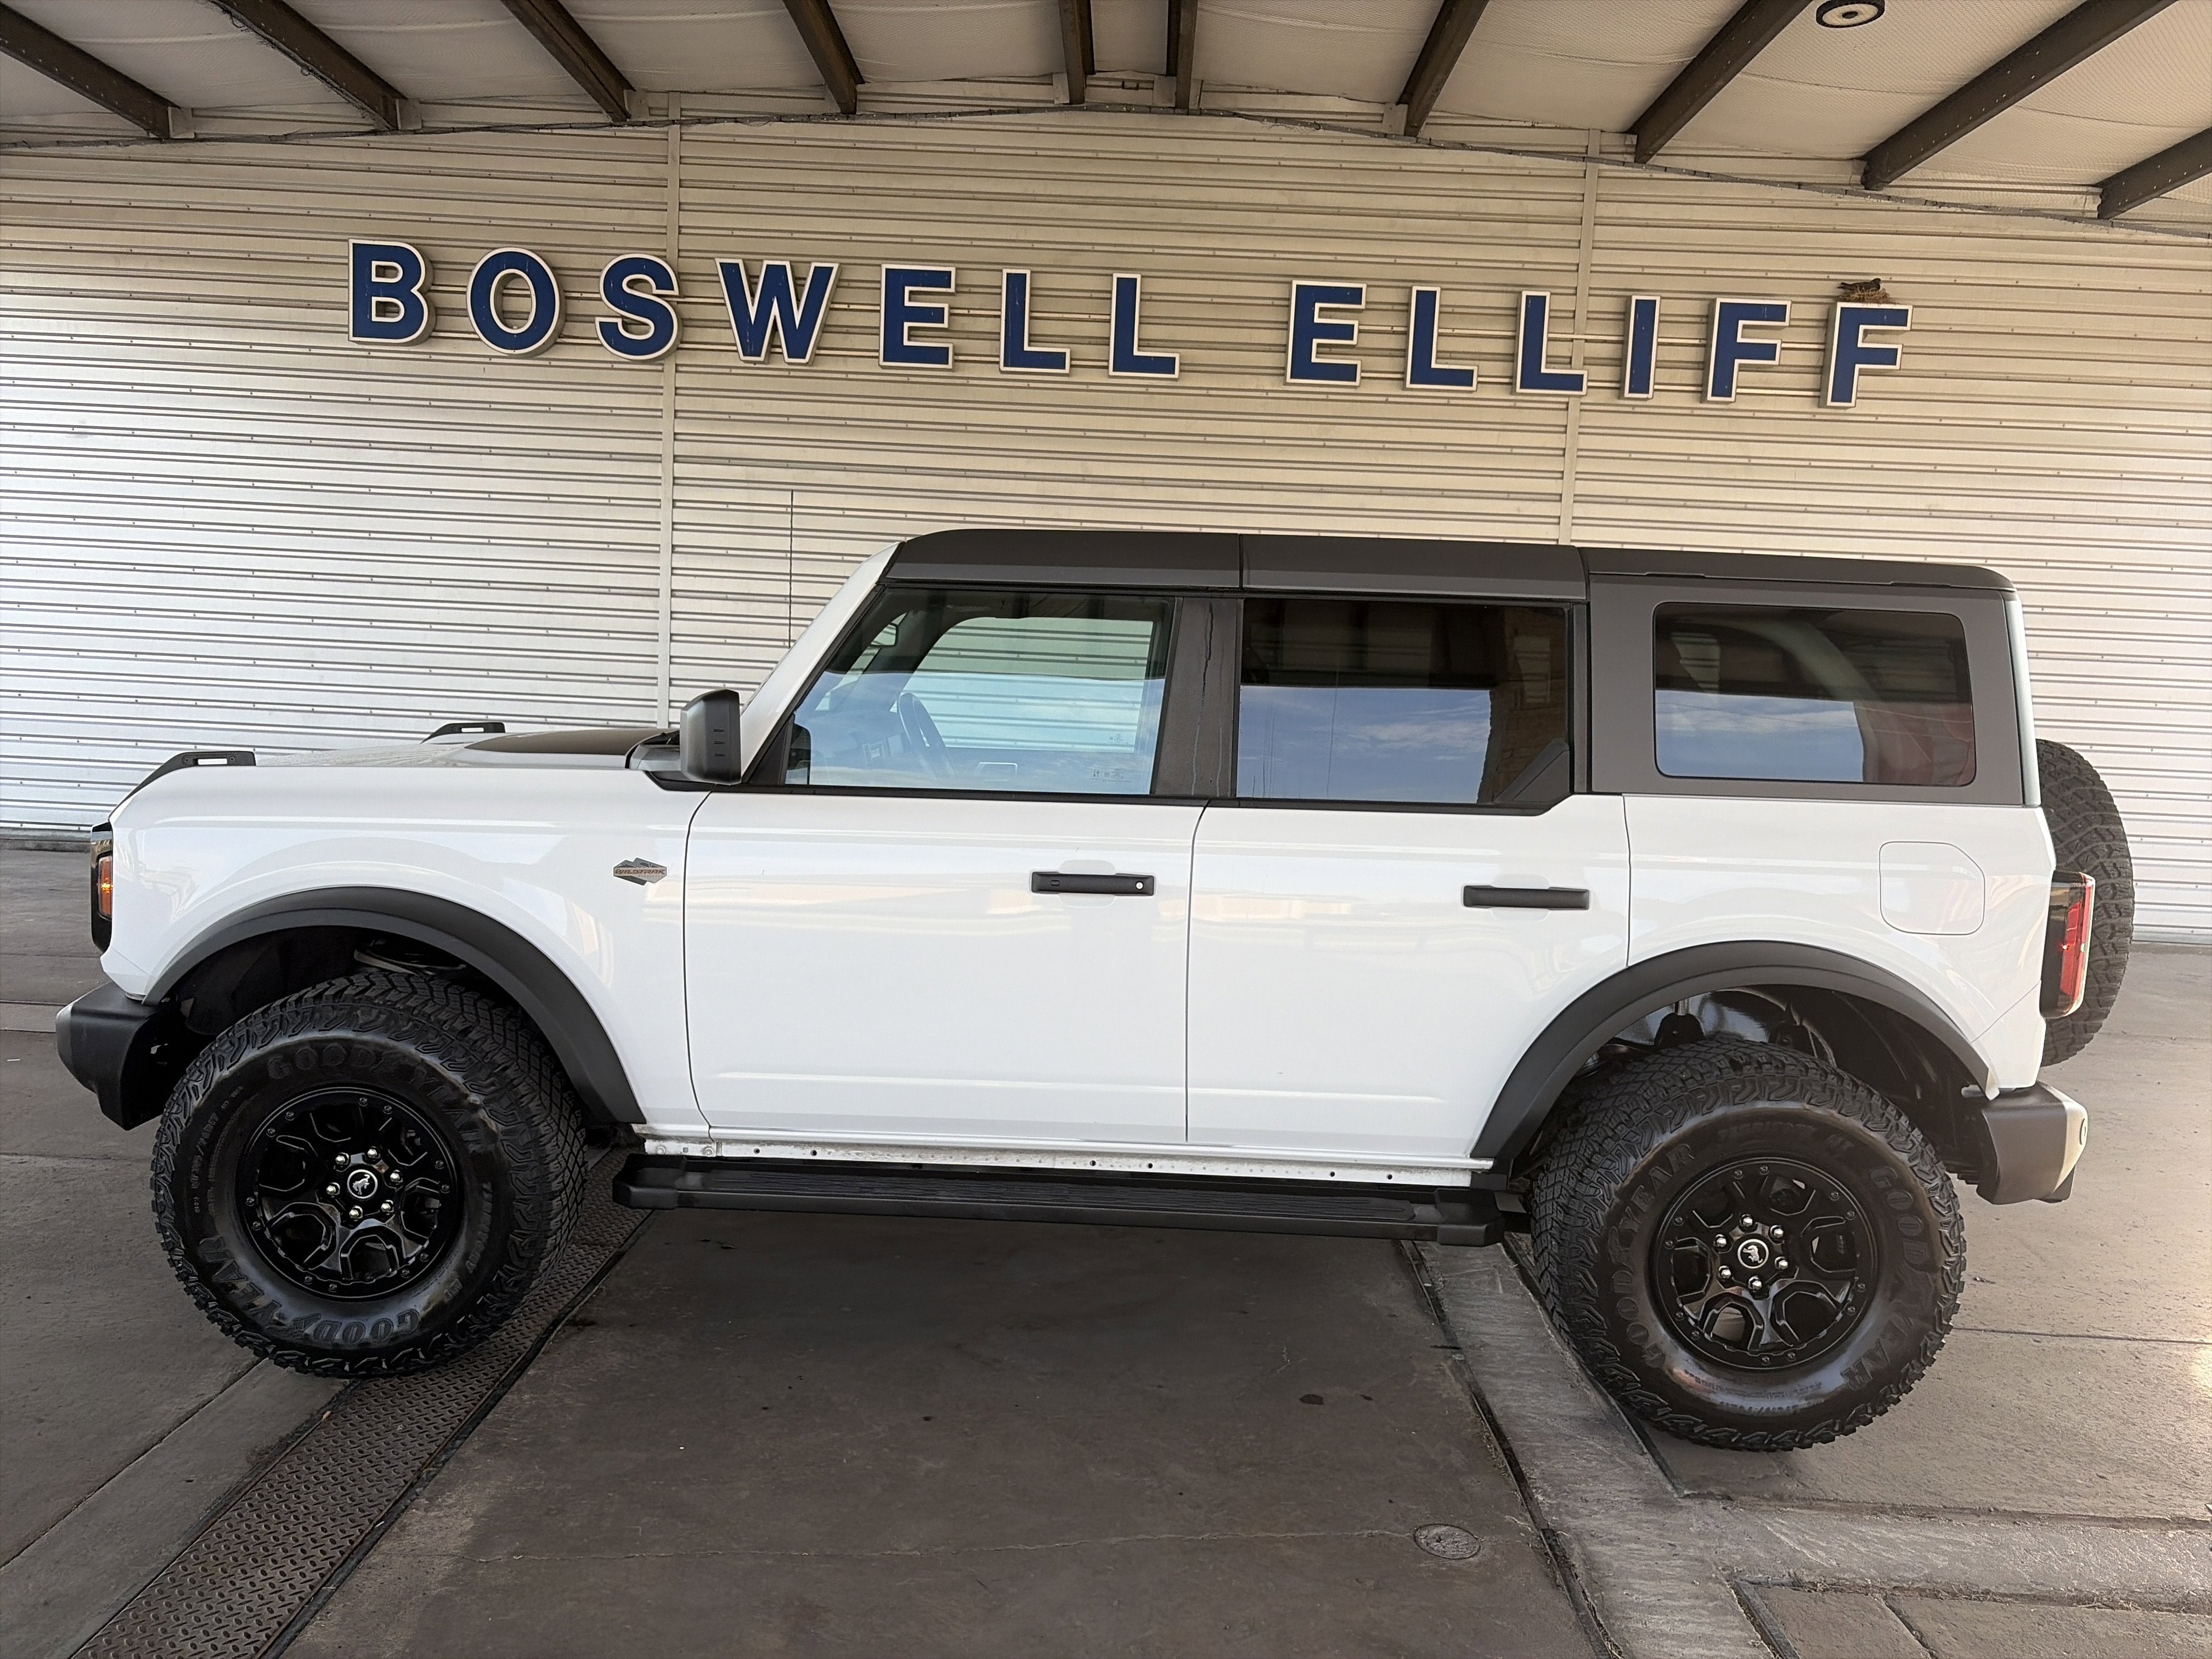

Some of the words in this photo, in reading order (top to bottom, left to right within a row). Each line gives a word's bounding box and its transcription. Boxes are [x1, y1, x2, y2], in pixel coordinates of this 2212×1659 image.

[348, 239, 1180, 379] BOSWELL
[1285, 280, 1914, 408] ELLIFF
[198, 1235, 421, 1345] GOODYEAR
[1609, 1143, 1695, 1368] GOODYEAR
